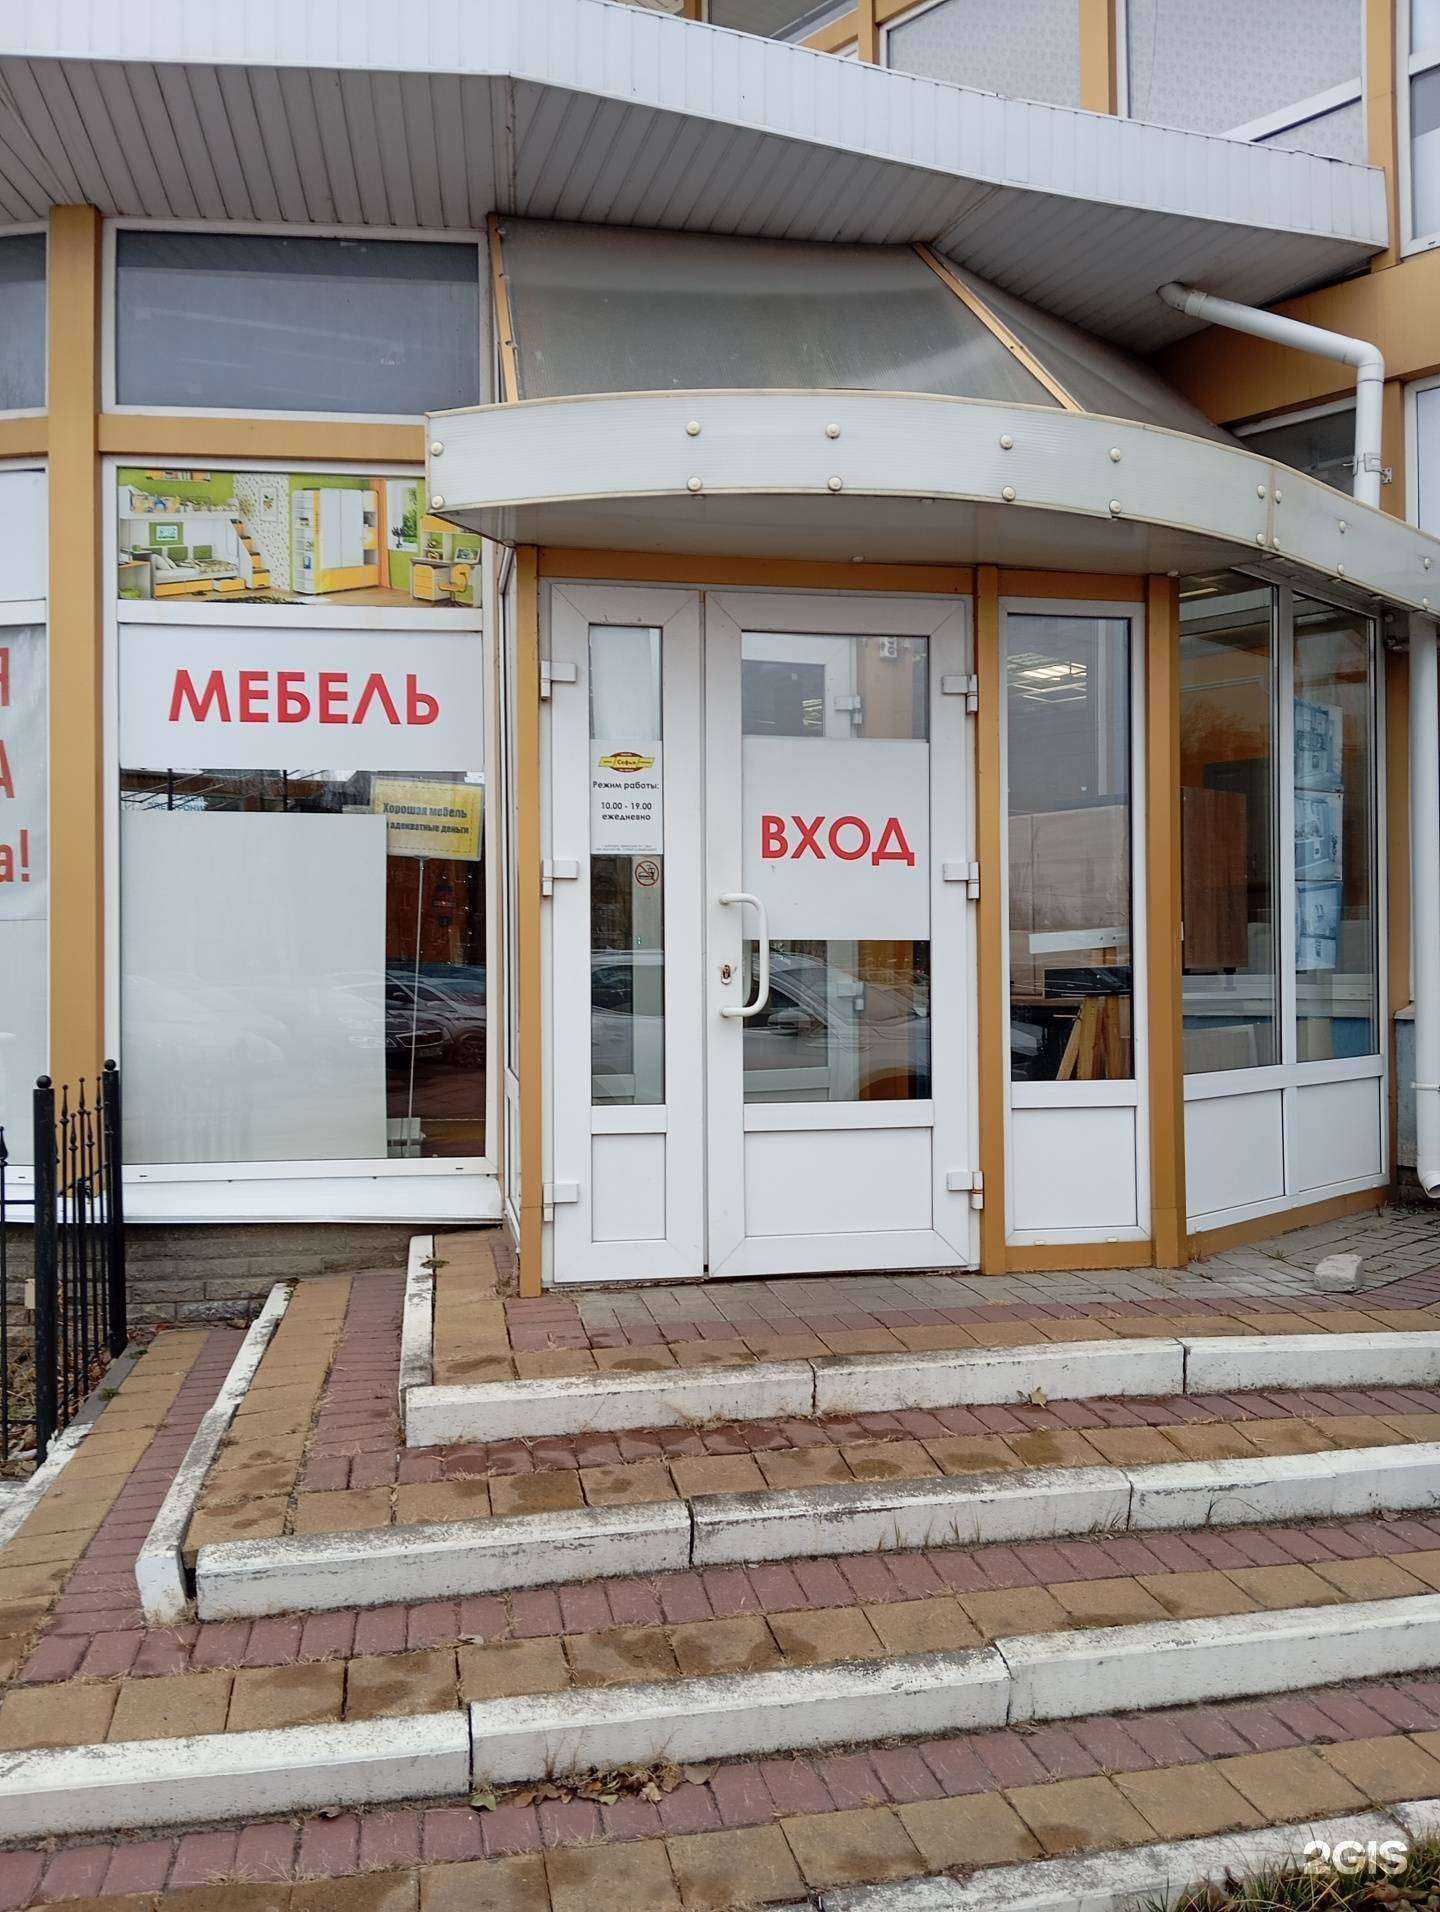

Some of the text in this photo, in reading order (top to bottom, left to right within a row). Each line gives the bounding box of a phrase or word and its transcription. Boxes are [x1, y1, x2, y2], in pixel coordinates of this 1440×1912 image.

[168, 669, 441, 727] МЕБЕЛЬ
[592, 780, 660, 791] Режим работы:
[383, 803, 468, 819] Хорошая мебель
[601, 801, 622, 810] 10.00
[631, 801, 652, 810] 19.00
[601, 813, 651, 821] ежедневно
[441, 825, 470, 834] деньги
[761, 815, 916, 868] ВХОД
